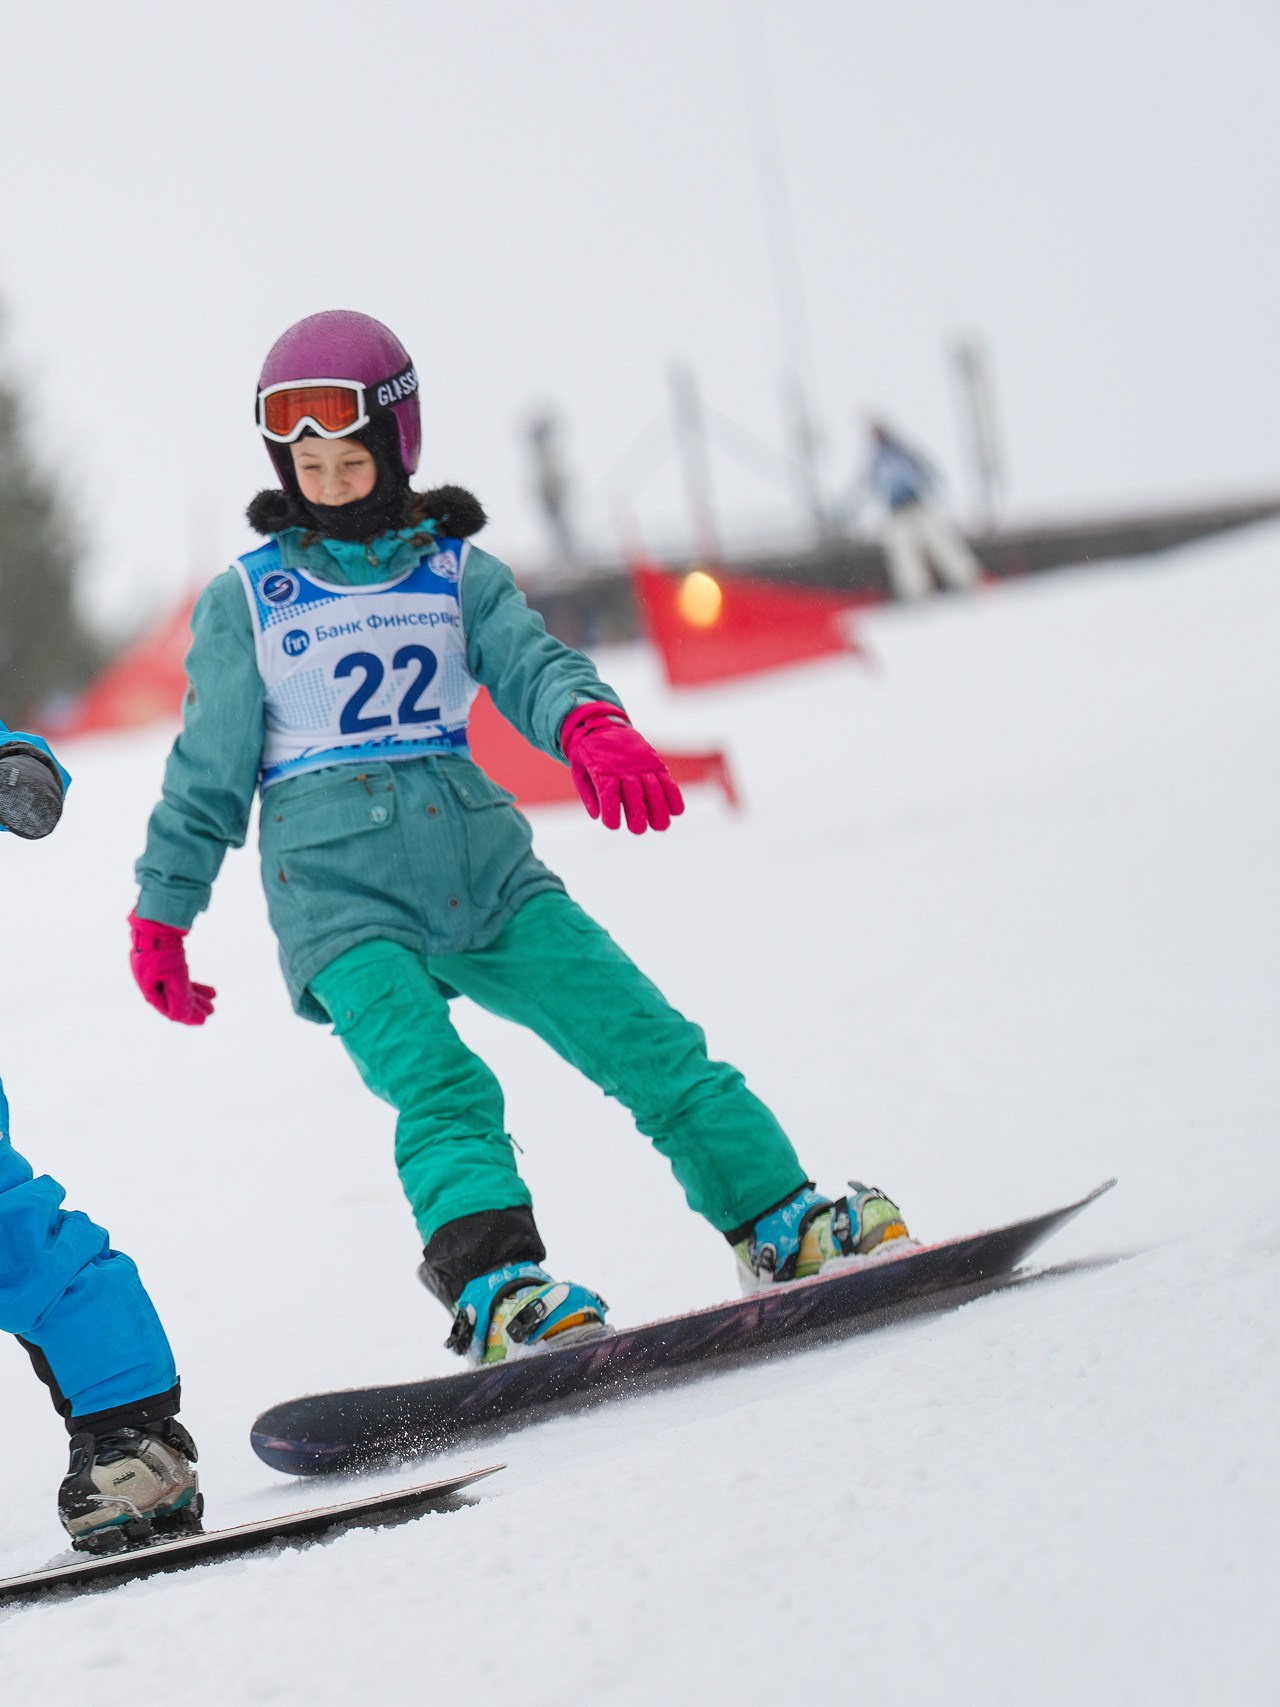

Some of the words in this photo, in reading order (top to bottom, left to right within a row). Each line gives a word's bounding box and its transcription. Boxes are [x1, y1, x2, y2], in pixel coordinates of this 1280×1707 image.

[315, 620, 363, 642] Банк
[366, 611, 460, 629] Финсервис
[333, 644, 441, 735] 22
